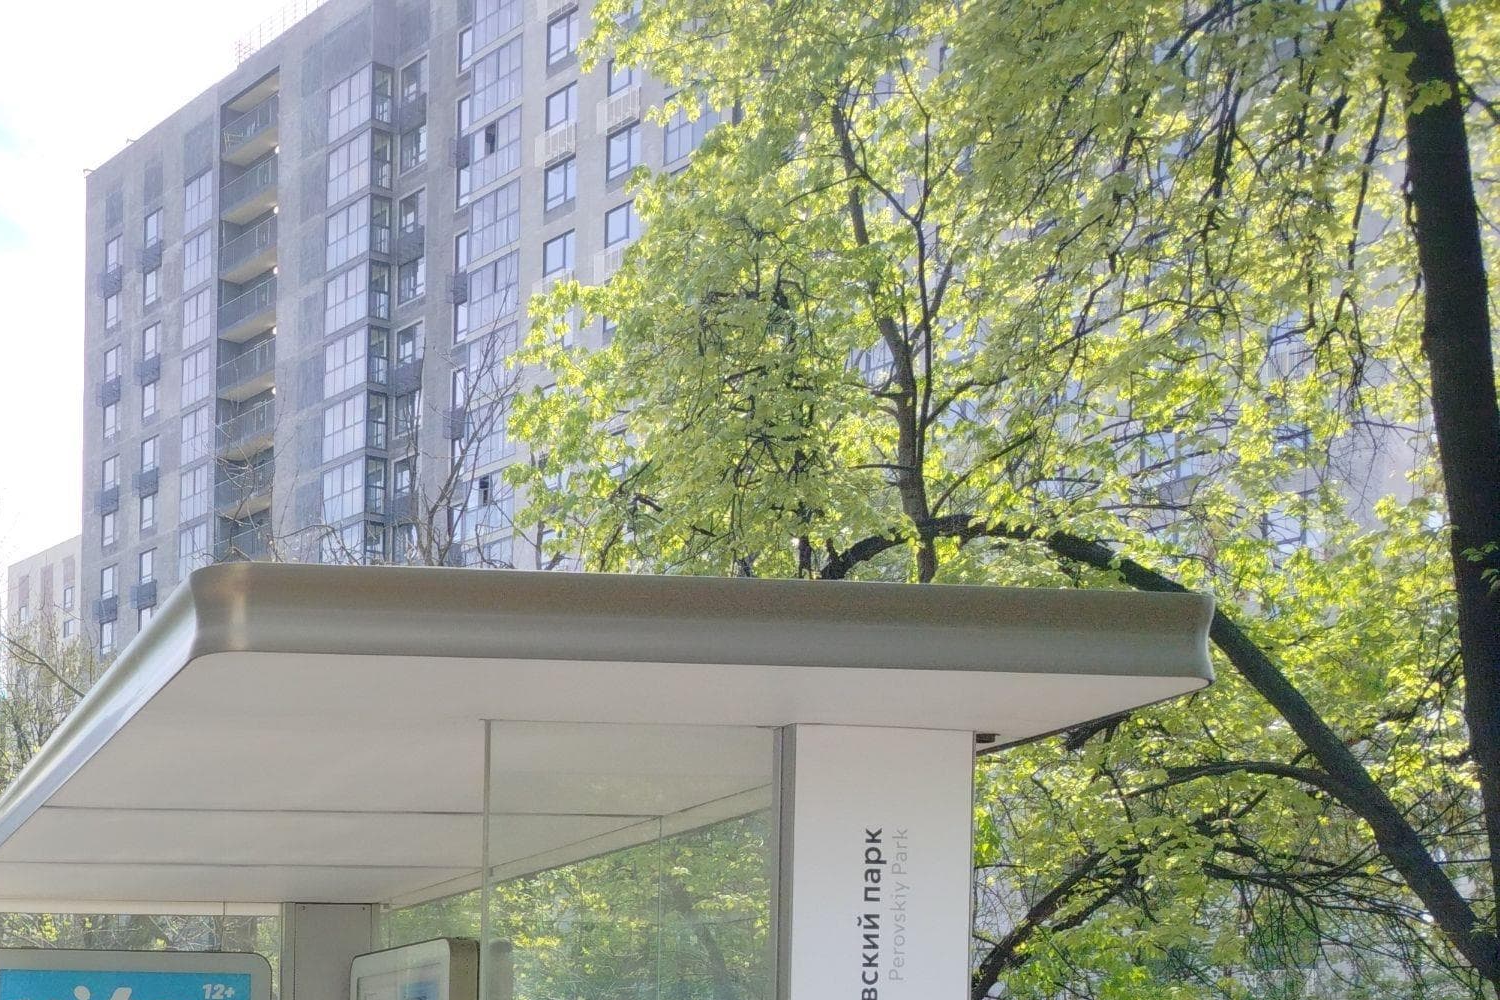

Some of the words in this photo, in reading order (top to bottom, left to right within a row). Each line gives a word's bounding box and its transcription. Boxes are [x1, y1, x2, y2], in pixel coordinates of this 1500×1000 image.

[863, 828, 887, 902] парк
[892, 828, 908, 875] Park
[889, 882, 910, 981] Perovskiy
[202, 984, 235, 999] 12+
